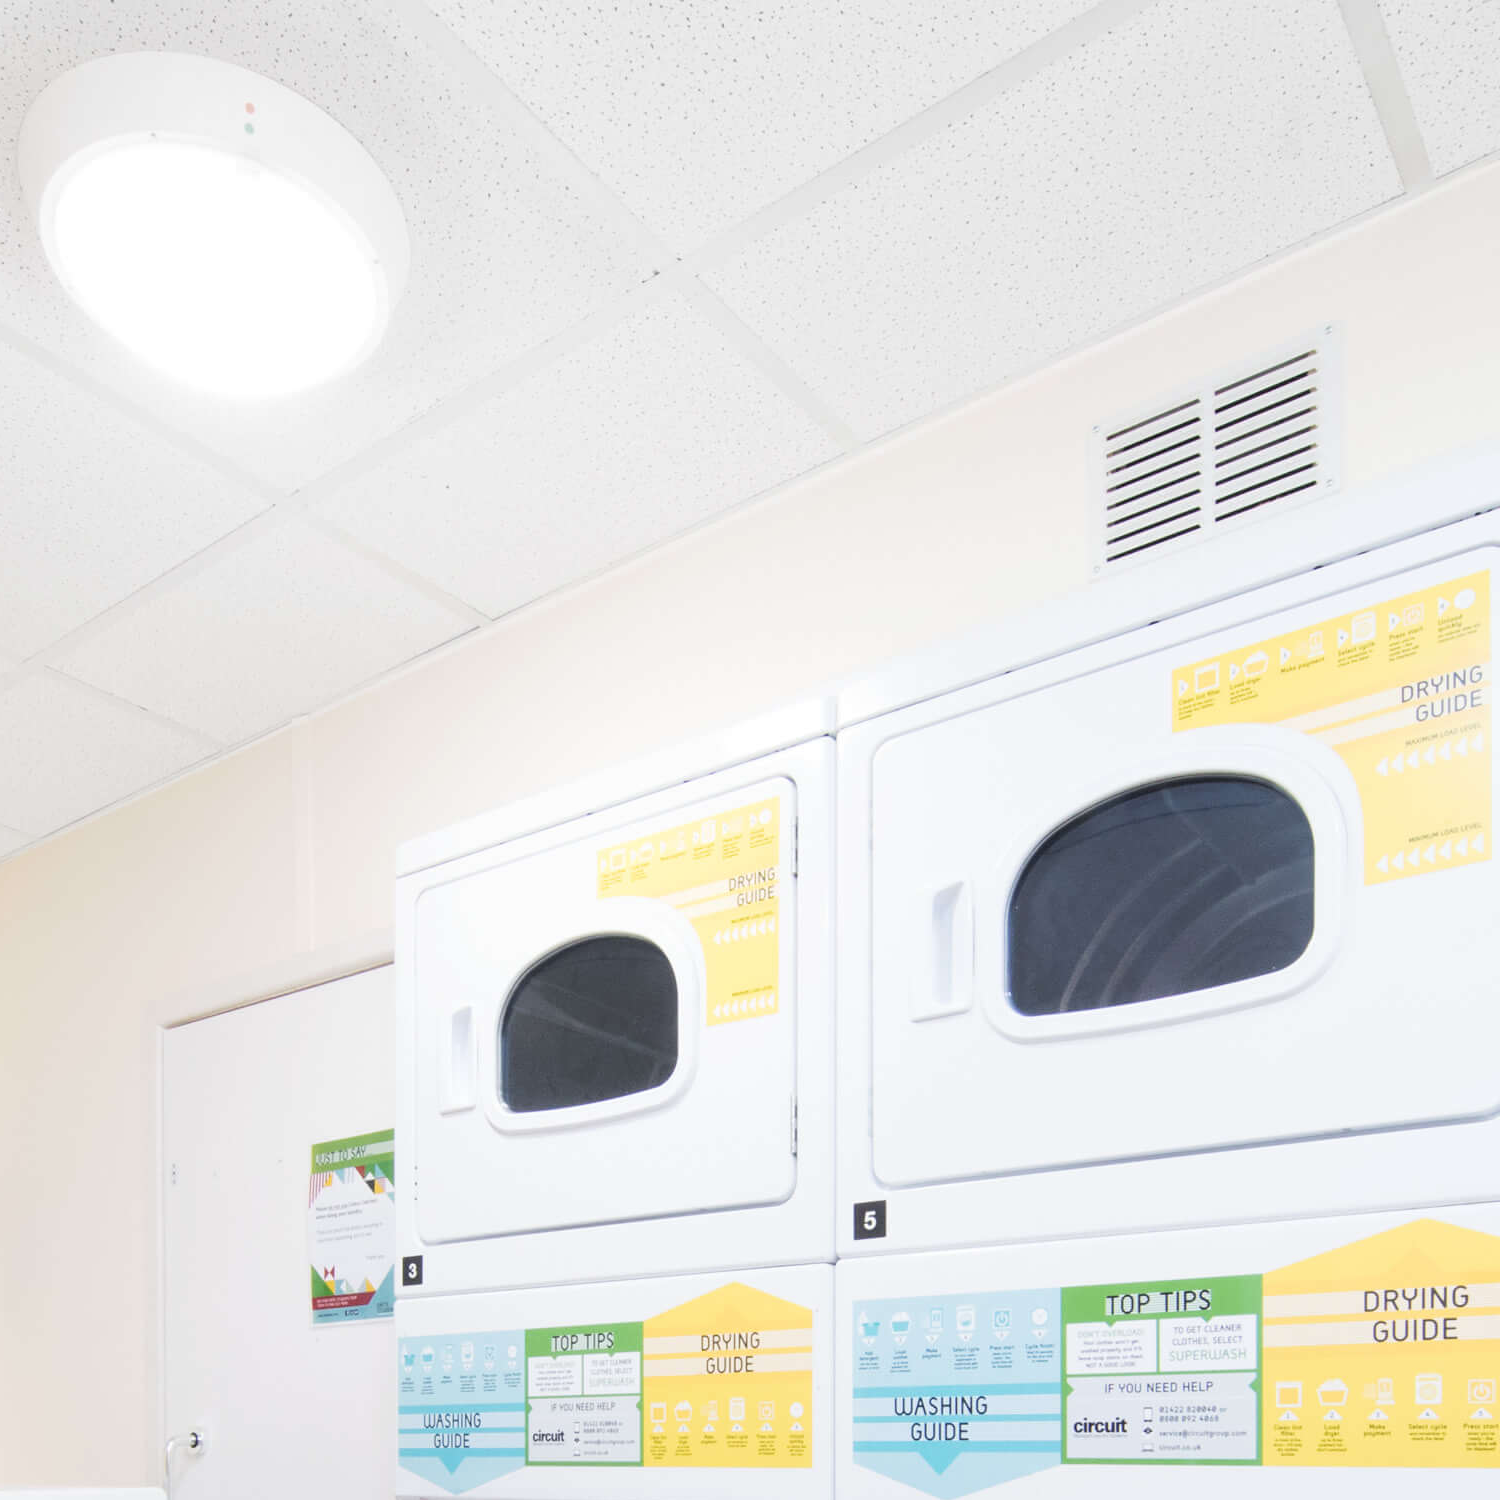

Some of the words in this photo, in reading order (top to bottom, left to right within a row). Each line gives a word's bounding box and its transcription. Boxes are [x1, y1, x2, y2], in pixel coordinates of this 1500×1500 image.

[1401, 666, 1483, 704] DRYING
[1416, 690, 1482, 722] GUIDE
[1405, 734, 1438, 747] MAXIMUM
[1440, 729, 1458, 739] LOAD
[1460, 723, 1480, 734] LEVEL
[729, 868, 775, 892] DRYING
[737, 886, 774, 907] GUIDE
[863, 1211, 877, 1230] 5
[408, 1262, 417, 1279] 3
[1106, 1293, 1150, 1315] TOP
[1160, 1290, 1211, 1312] TIPS
[1364, 1285, 1469, 1312] DRYING
[1174, 1326, 1184, 1334] TO
[1187, 1325, 1200, 1334] GET
[1204, 1324, 1241, 1333] CLEANER
[1373, 1318, 1458, 1342] GUIDE
[552, 1335, 578, 1351] TOP
[585, 1332, 614, 1349] TIPS
[701, 1332, 760, 1352] DRYING
[1212, 1336, 1242, 1344] SELECT
[1169, 1349, 1246, 1361] SUPERWASH
[706, 1356, 754, 1374] GUIDE
[1104, 1384, 1114, 1393] IF
[1119, 1384, 1142, 1393] YOU
[1147, 1382, 1177, 1392] NEED
[1183, 1381, 1213, 1391] HELP
[551, 1403, 556, 1411] IF
[559, 1403, 574, 1411] YOU
[576, 1402, 594, 1411] NEED
[597, 1402, 616, 1410] HELP
[894, 1395, 988, 1416] WASHING
[423, 1413, 481, 1429] WASHING
[1074, 1417, 1127, 1433] circuit
[434, 1434, 470, 1448] GUIDE
[533, 1429, 564, 1442] circuit
[911, 1422, 969, 1441] GUIDE
